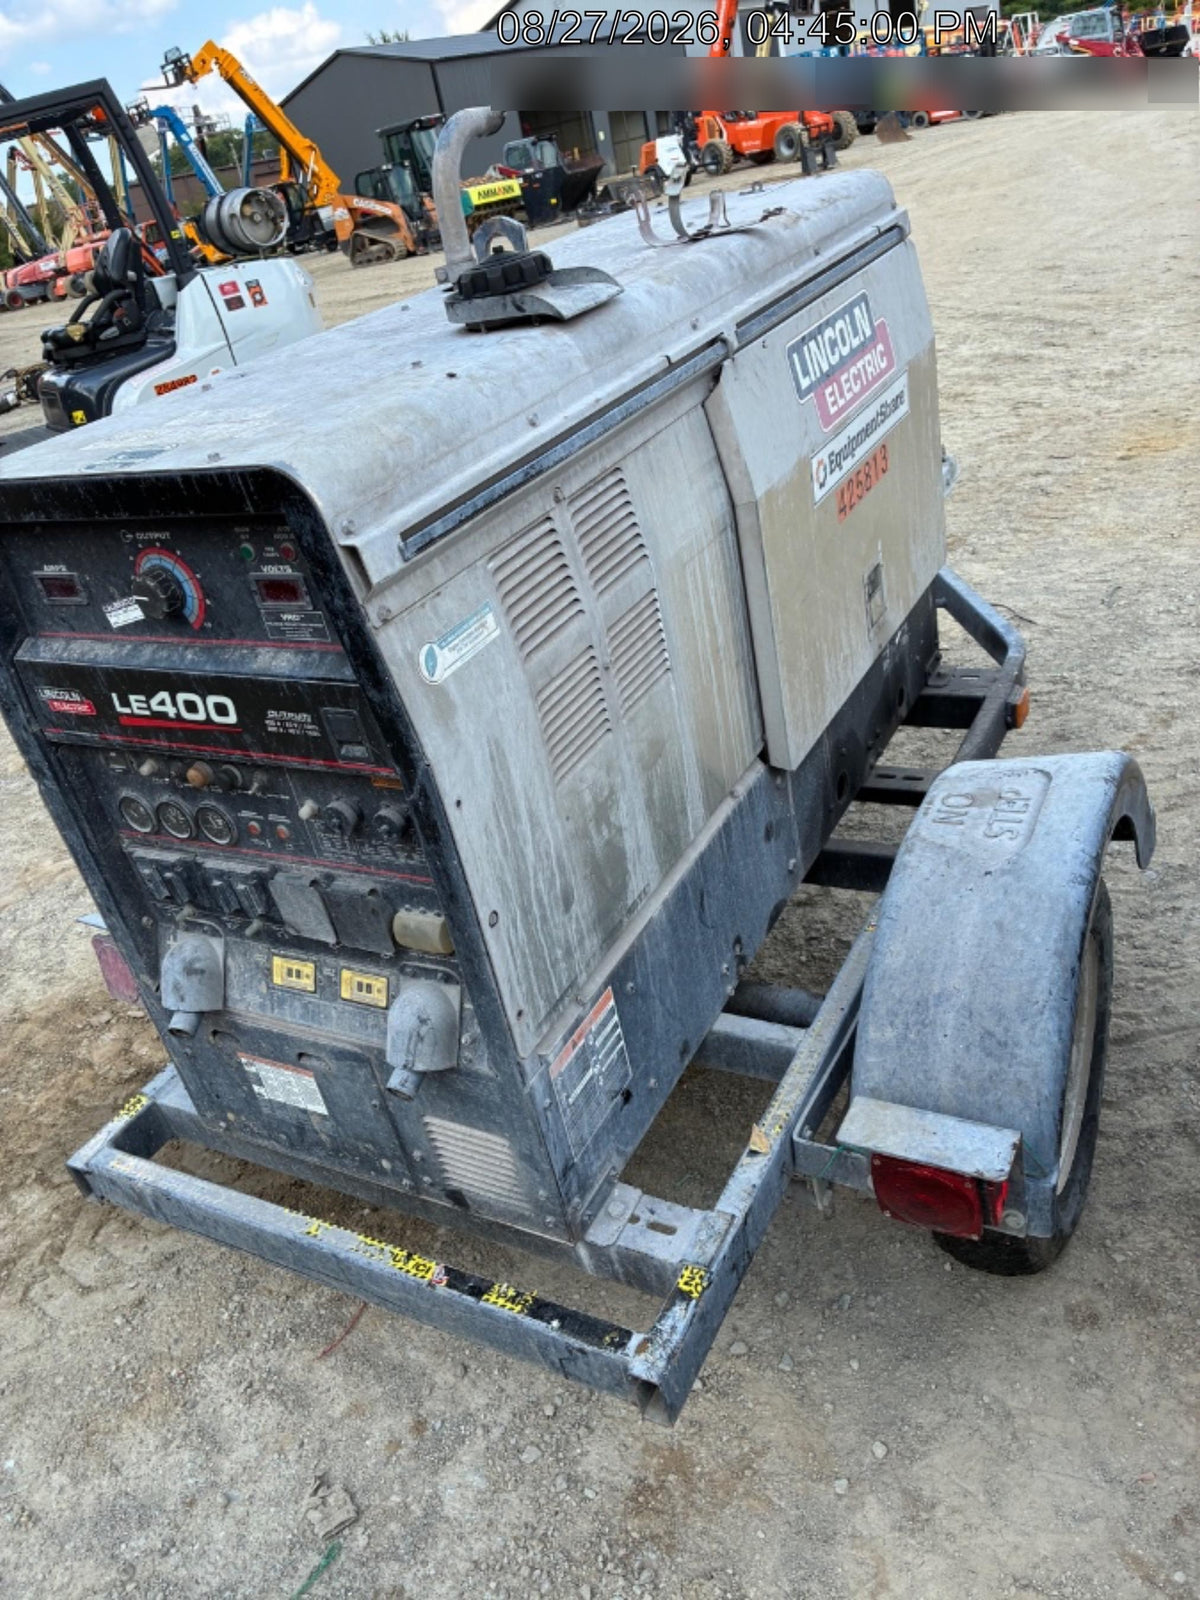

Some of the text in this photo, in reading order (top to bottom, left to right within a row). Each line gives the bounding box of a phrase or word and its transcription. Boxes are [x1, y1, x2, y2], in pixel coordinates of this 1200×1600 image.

[792, 301, 873, 390] LINCOLN
[823, 342, 888, 416] ELECTRIC
[827, 388, 905, 477] EquipmentShare
[111, 690, 238, 725] LE400
[931, 792, 975, 825] NO
[983, 787, 1032, 840] STEP
